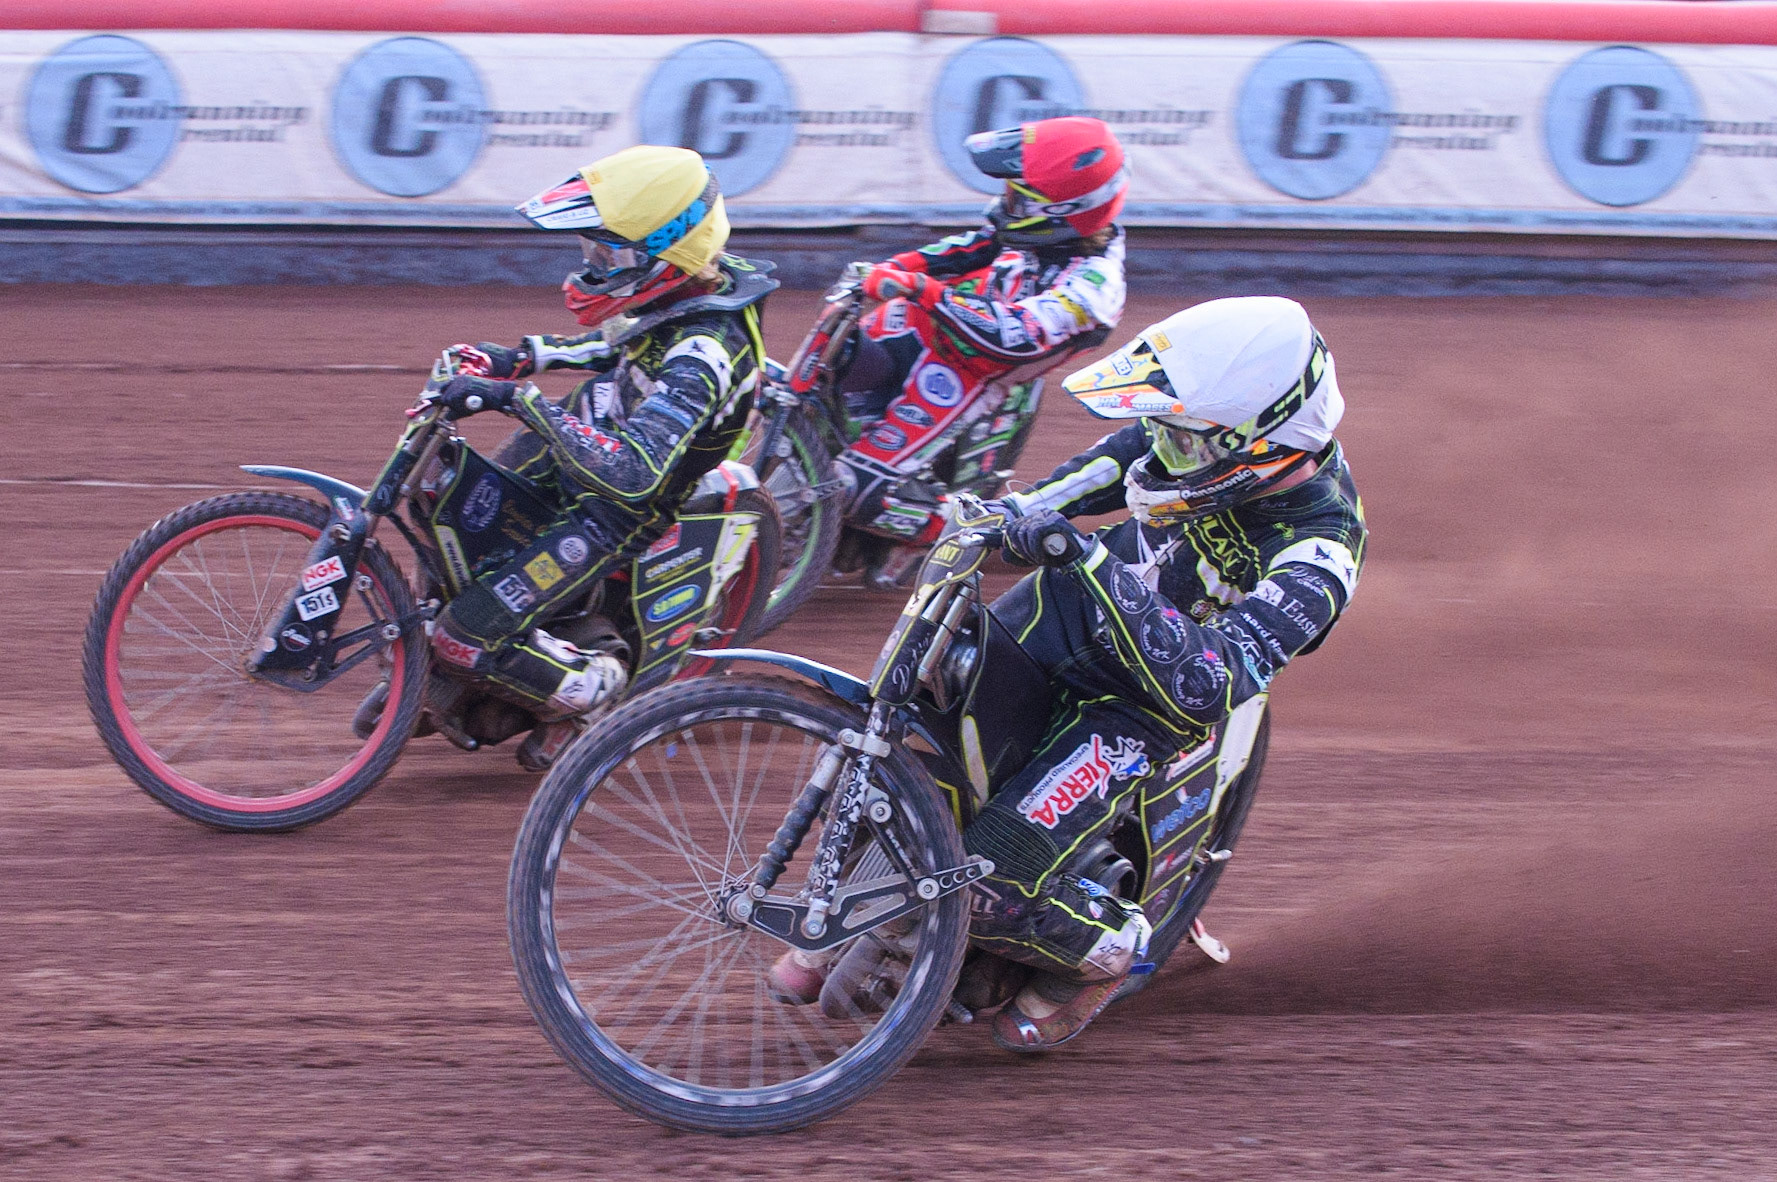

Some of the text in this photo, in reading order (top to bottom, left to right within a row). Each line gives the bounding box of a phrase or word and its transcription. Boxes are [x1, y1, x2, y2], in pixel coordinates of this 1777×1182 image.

[1181, 469, 1253, 500] Panasonic
[722, 523, 757, 564] 7
[304, 560, 340, 583] NGK
[1019, 776, 1055, 812] PRODUCTS
[1030, 736, 1111, 827] SIERRA
